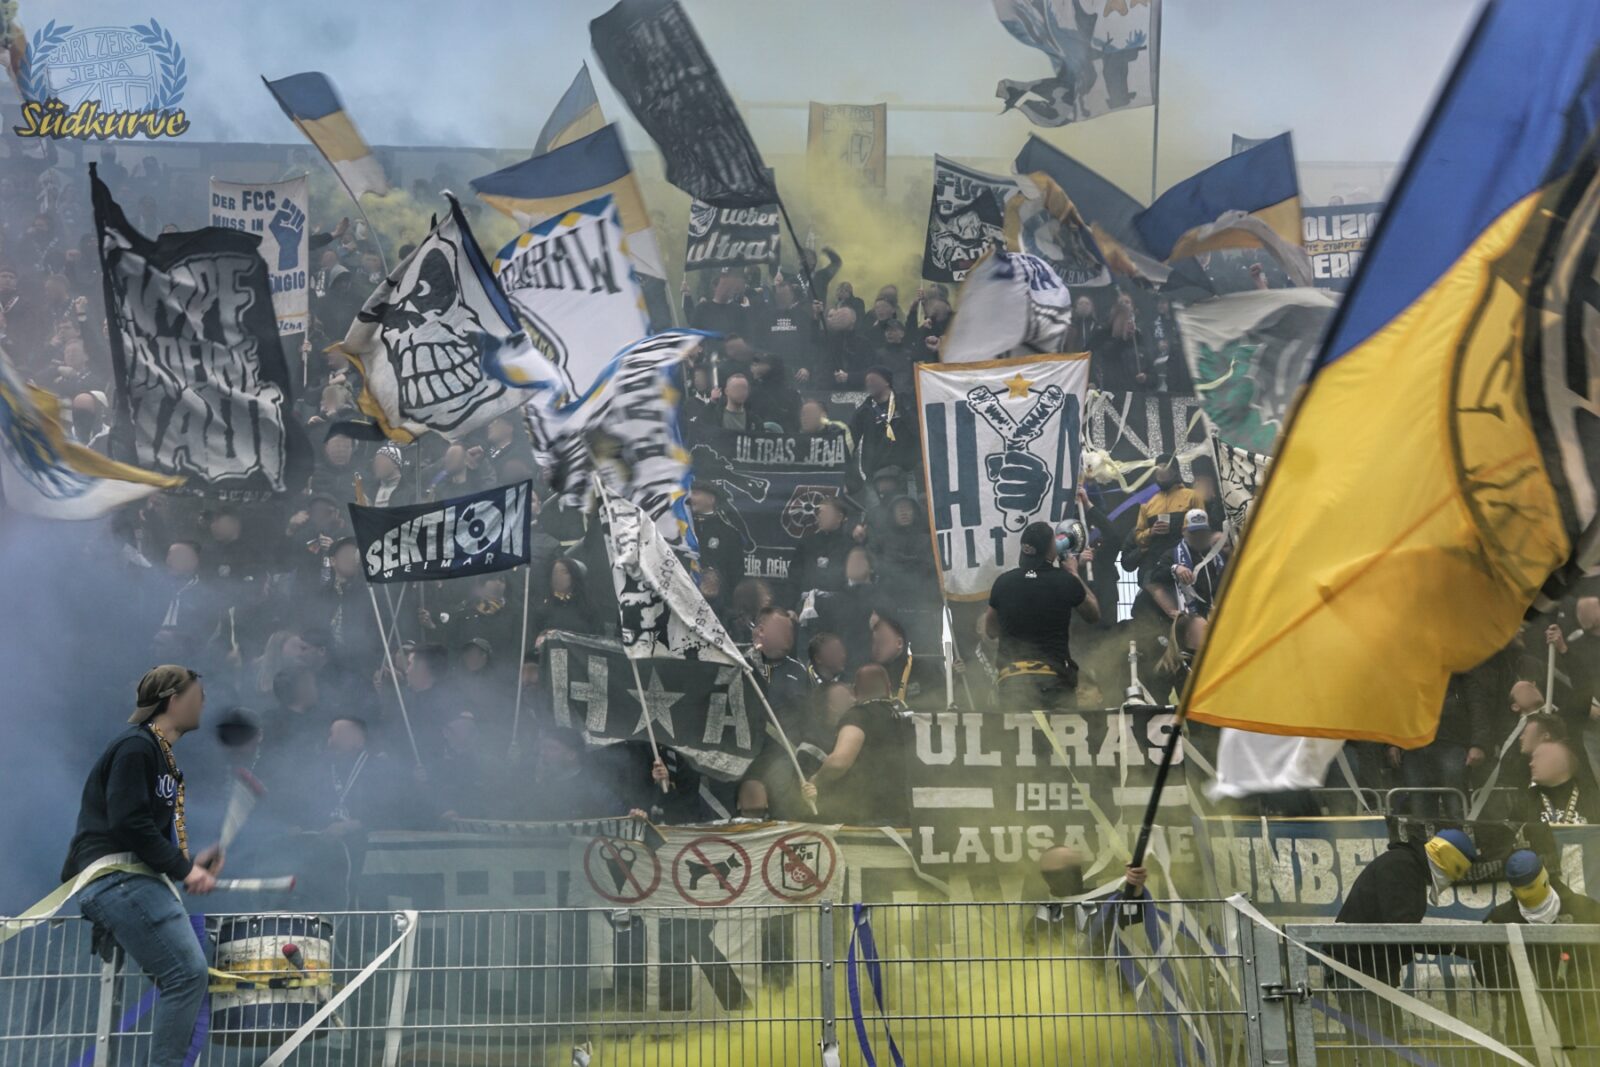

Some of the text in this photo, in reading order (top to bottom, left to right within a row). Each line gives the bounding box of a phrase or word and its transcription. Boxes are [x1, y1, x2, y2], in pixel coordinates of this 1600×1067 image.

[212, 190, 276, 212] DER FCC
[212, 214, 264, 232] MUSS IN
[734, 434, 846, 467] ULTRAS JENA
[366, 482, 528, 577] SEKTION
[935, 525, 1008, 573] ULT
[384, 552, 494, 578] WEIMAR
[911, 712, 1187, 766] ULTRAS
[1015, 782, 1092, 811] 1993
